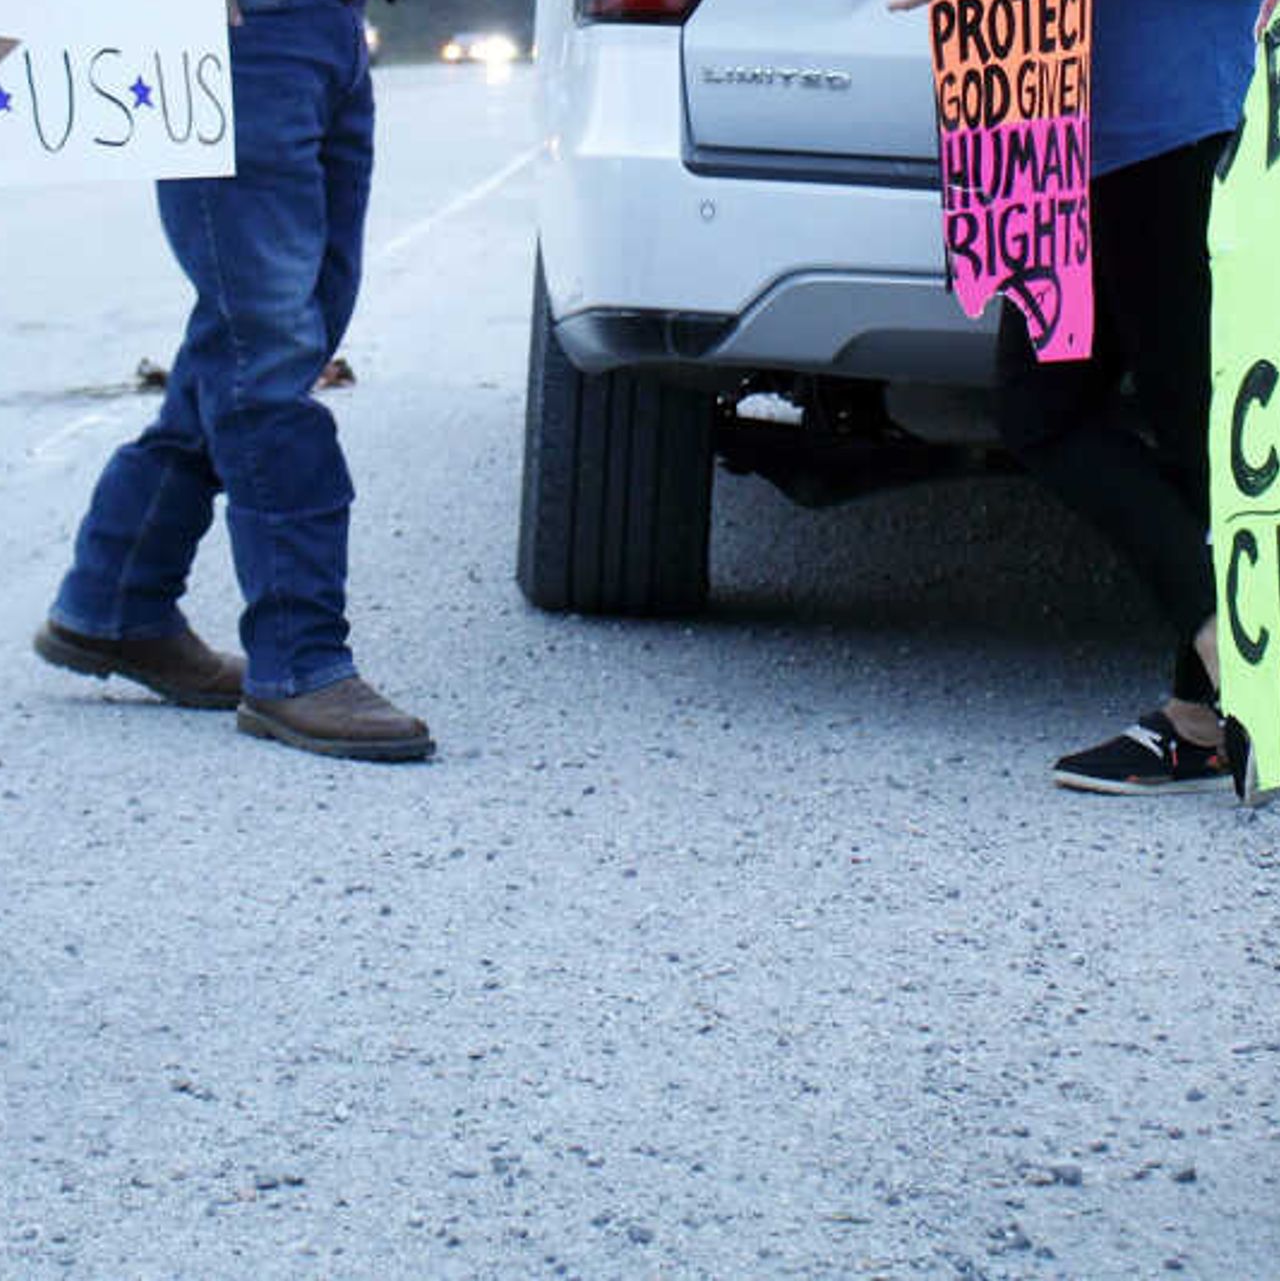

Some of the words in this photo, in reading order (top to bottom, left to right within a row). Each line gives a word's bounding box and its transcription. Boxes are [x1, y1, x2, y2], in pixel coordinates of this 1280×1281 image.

[23, 48, 135, 153] US
[154, 49, 227, 146] US
[699, 65, 852, 90] LIMITED
[939, 63, 1011, 132] GOD
[1016, 55, 1088, 120] GIVEN
[945, 120, 1087, 211] HUMAN
[947, 195, 1089, 281] RIGHTS
